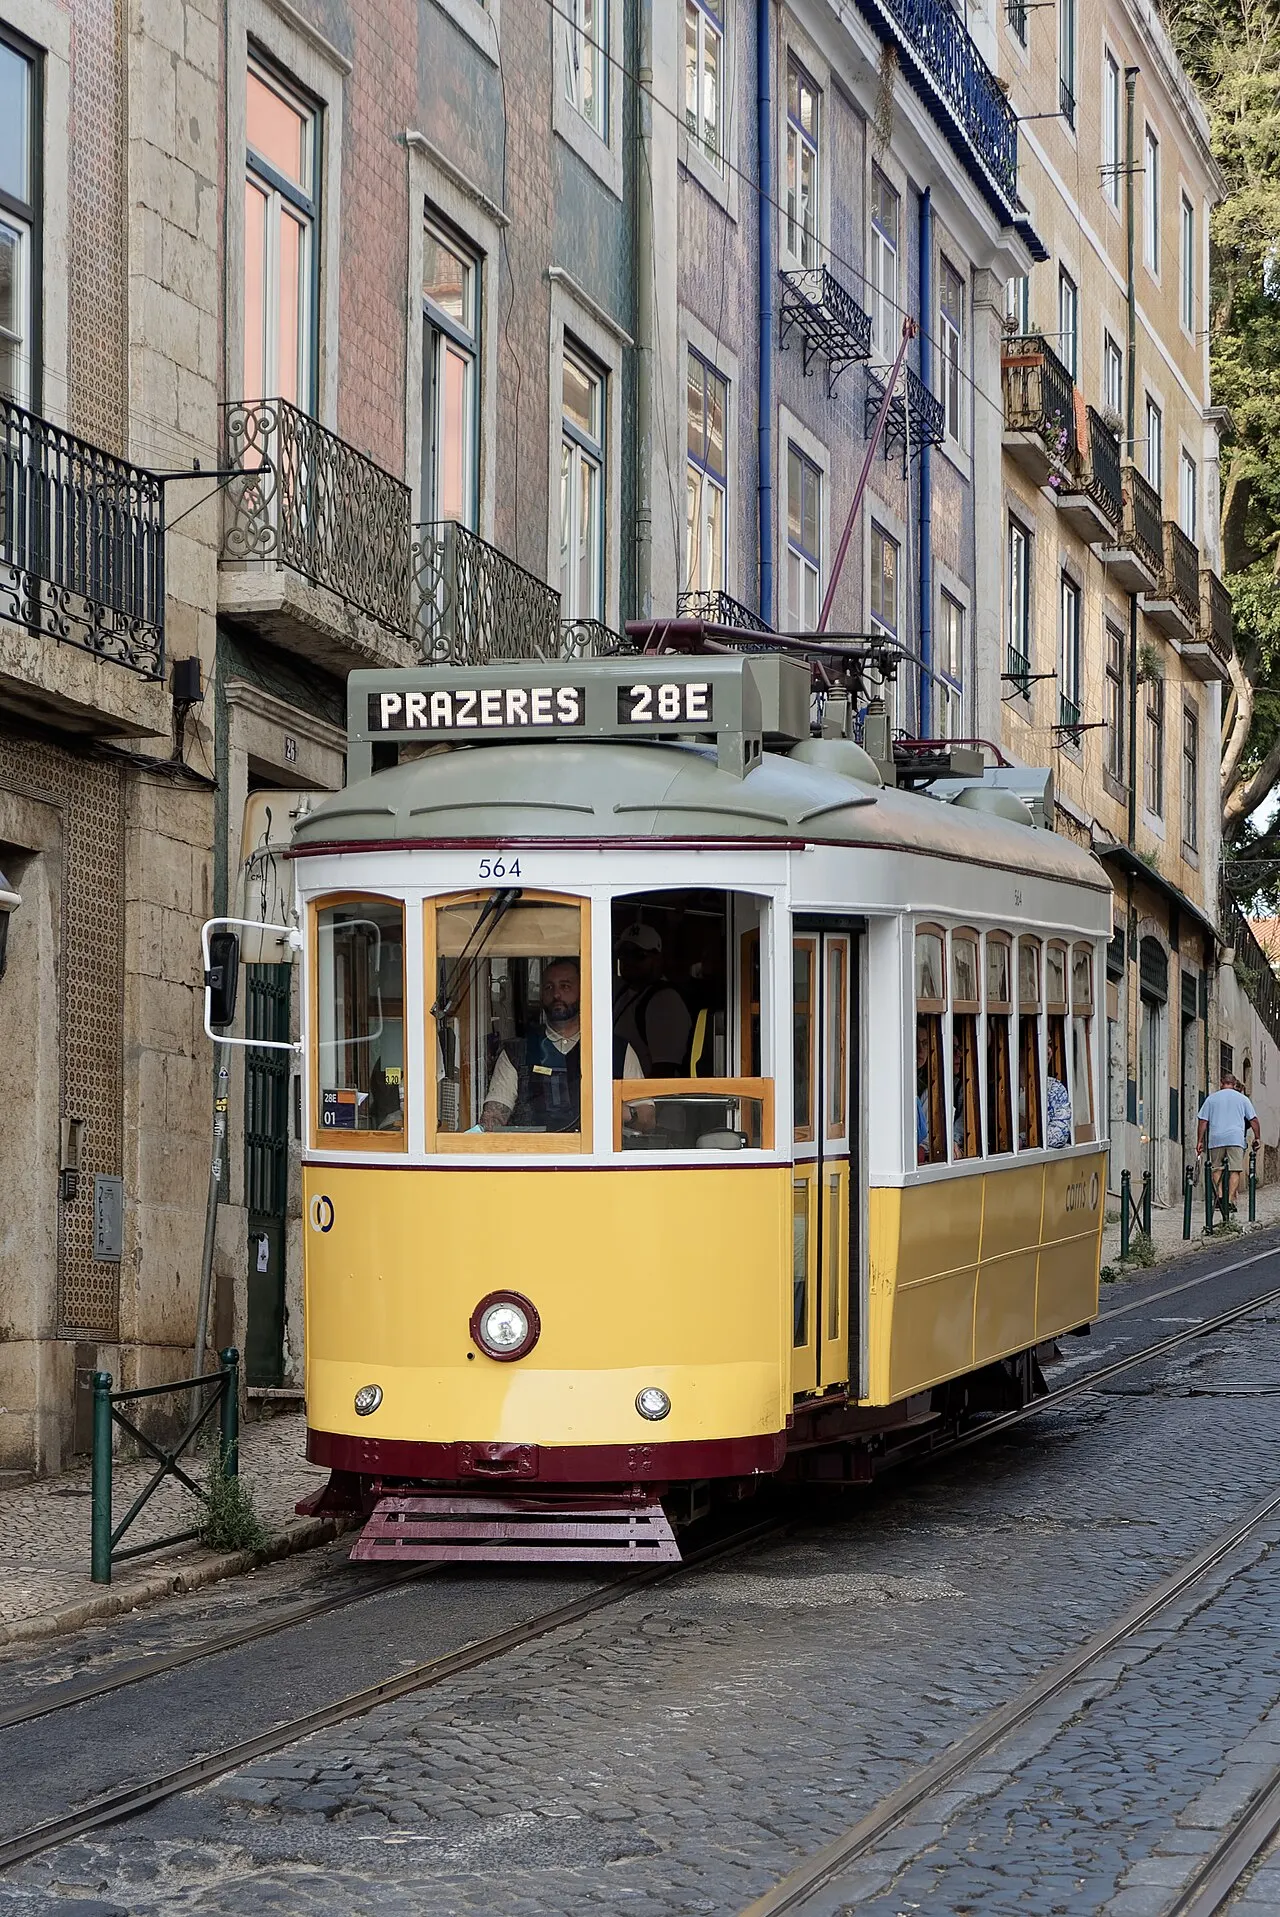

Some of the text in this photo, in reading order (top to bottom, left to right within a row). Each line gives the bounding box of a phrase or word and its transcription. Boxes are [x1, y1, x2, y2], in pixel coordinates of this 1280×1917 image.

[380, 683, 707, 728] PRAZERES 28E
[286, 738, 296, 761] 26
[479, 857, 521, 878] 564
[324, 1093, 337, 1103] 28E
[324, 1111, 336, 1125] 01
